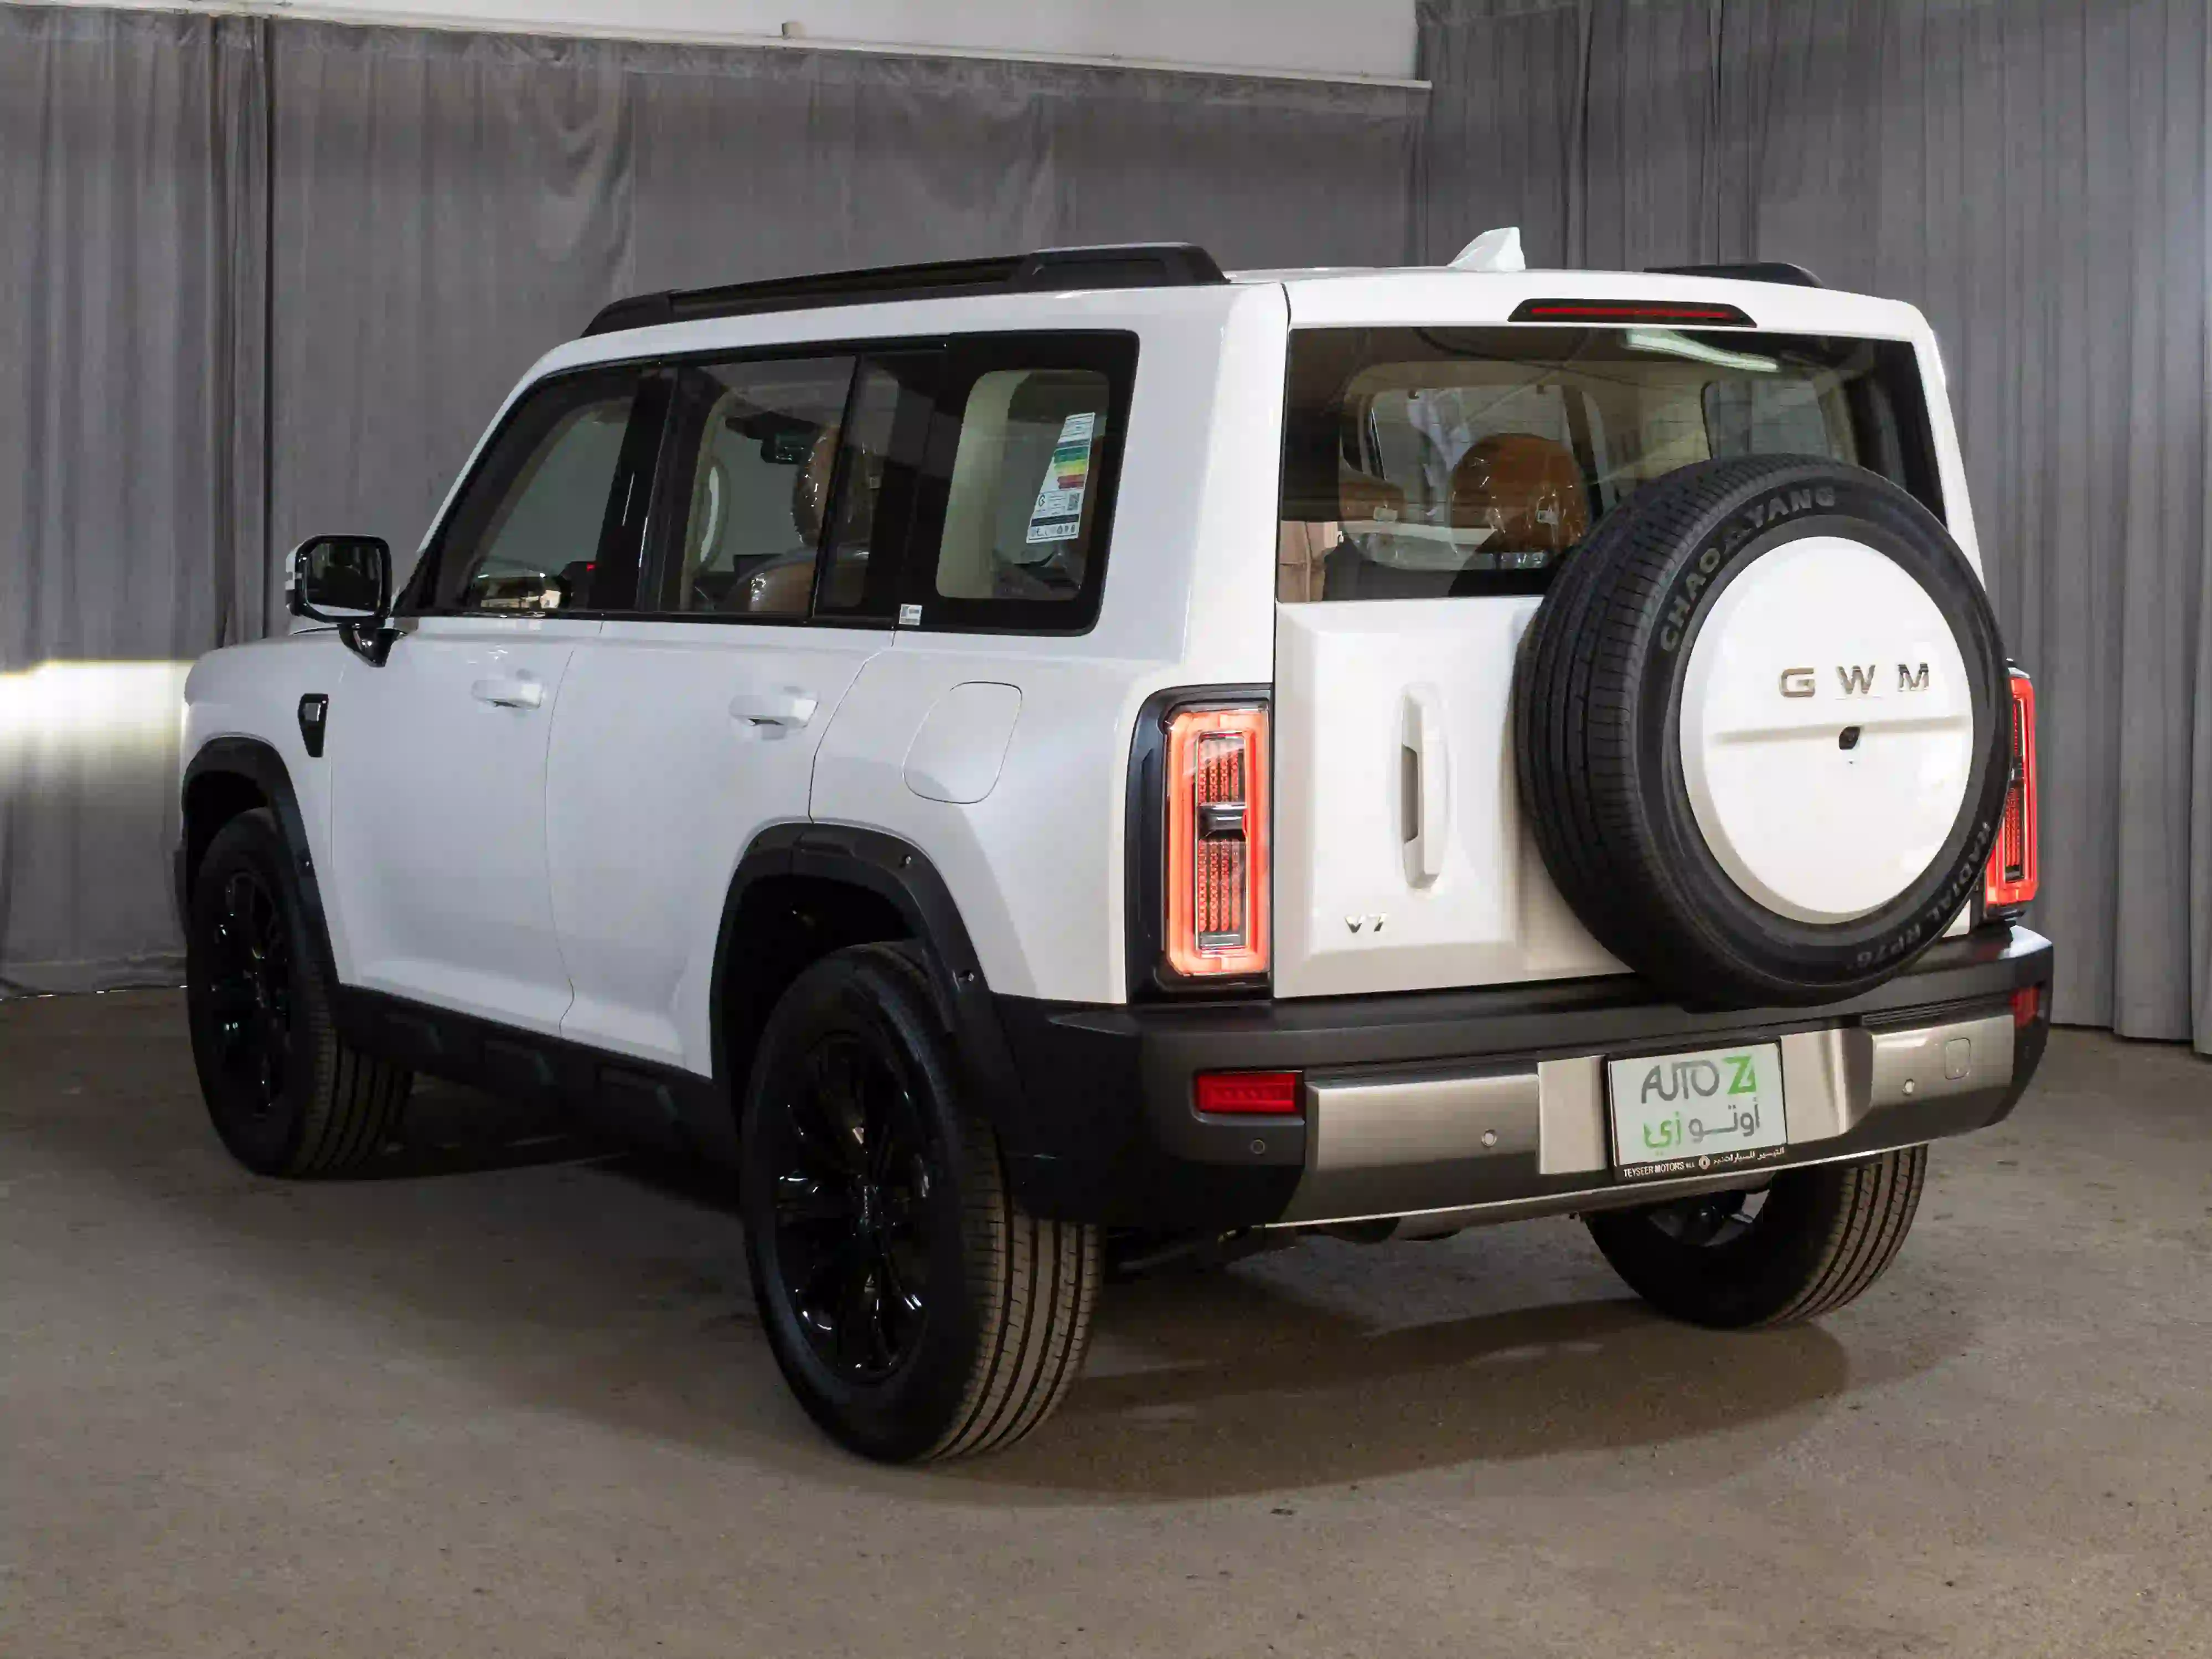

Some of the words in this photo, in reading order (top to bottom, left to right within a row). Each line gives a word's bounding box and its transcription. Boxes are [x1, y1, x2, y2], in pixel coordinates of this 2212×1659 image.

[1641, 1060, 1719, 1104] AUTO
[1624, 1166, 1653, 1178] TEYSEER
[1655, 1161, 1684, 1173] MOTORS
